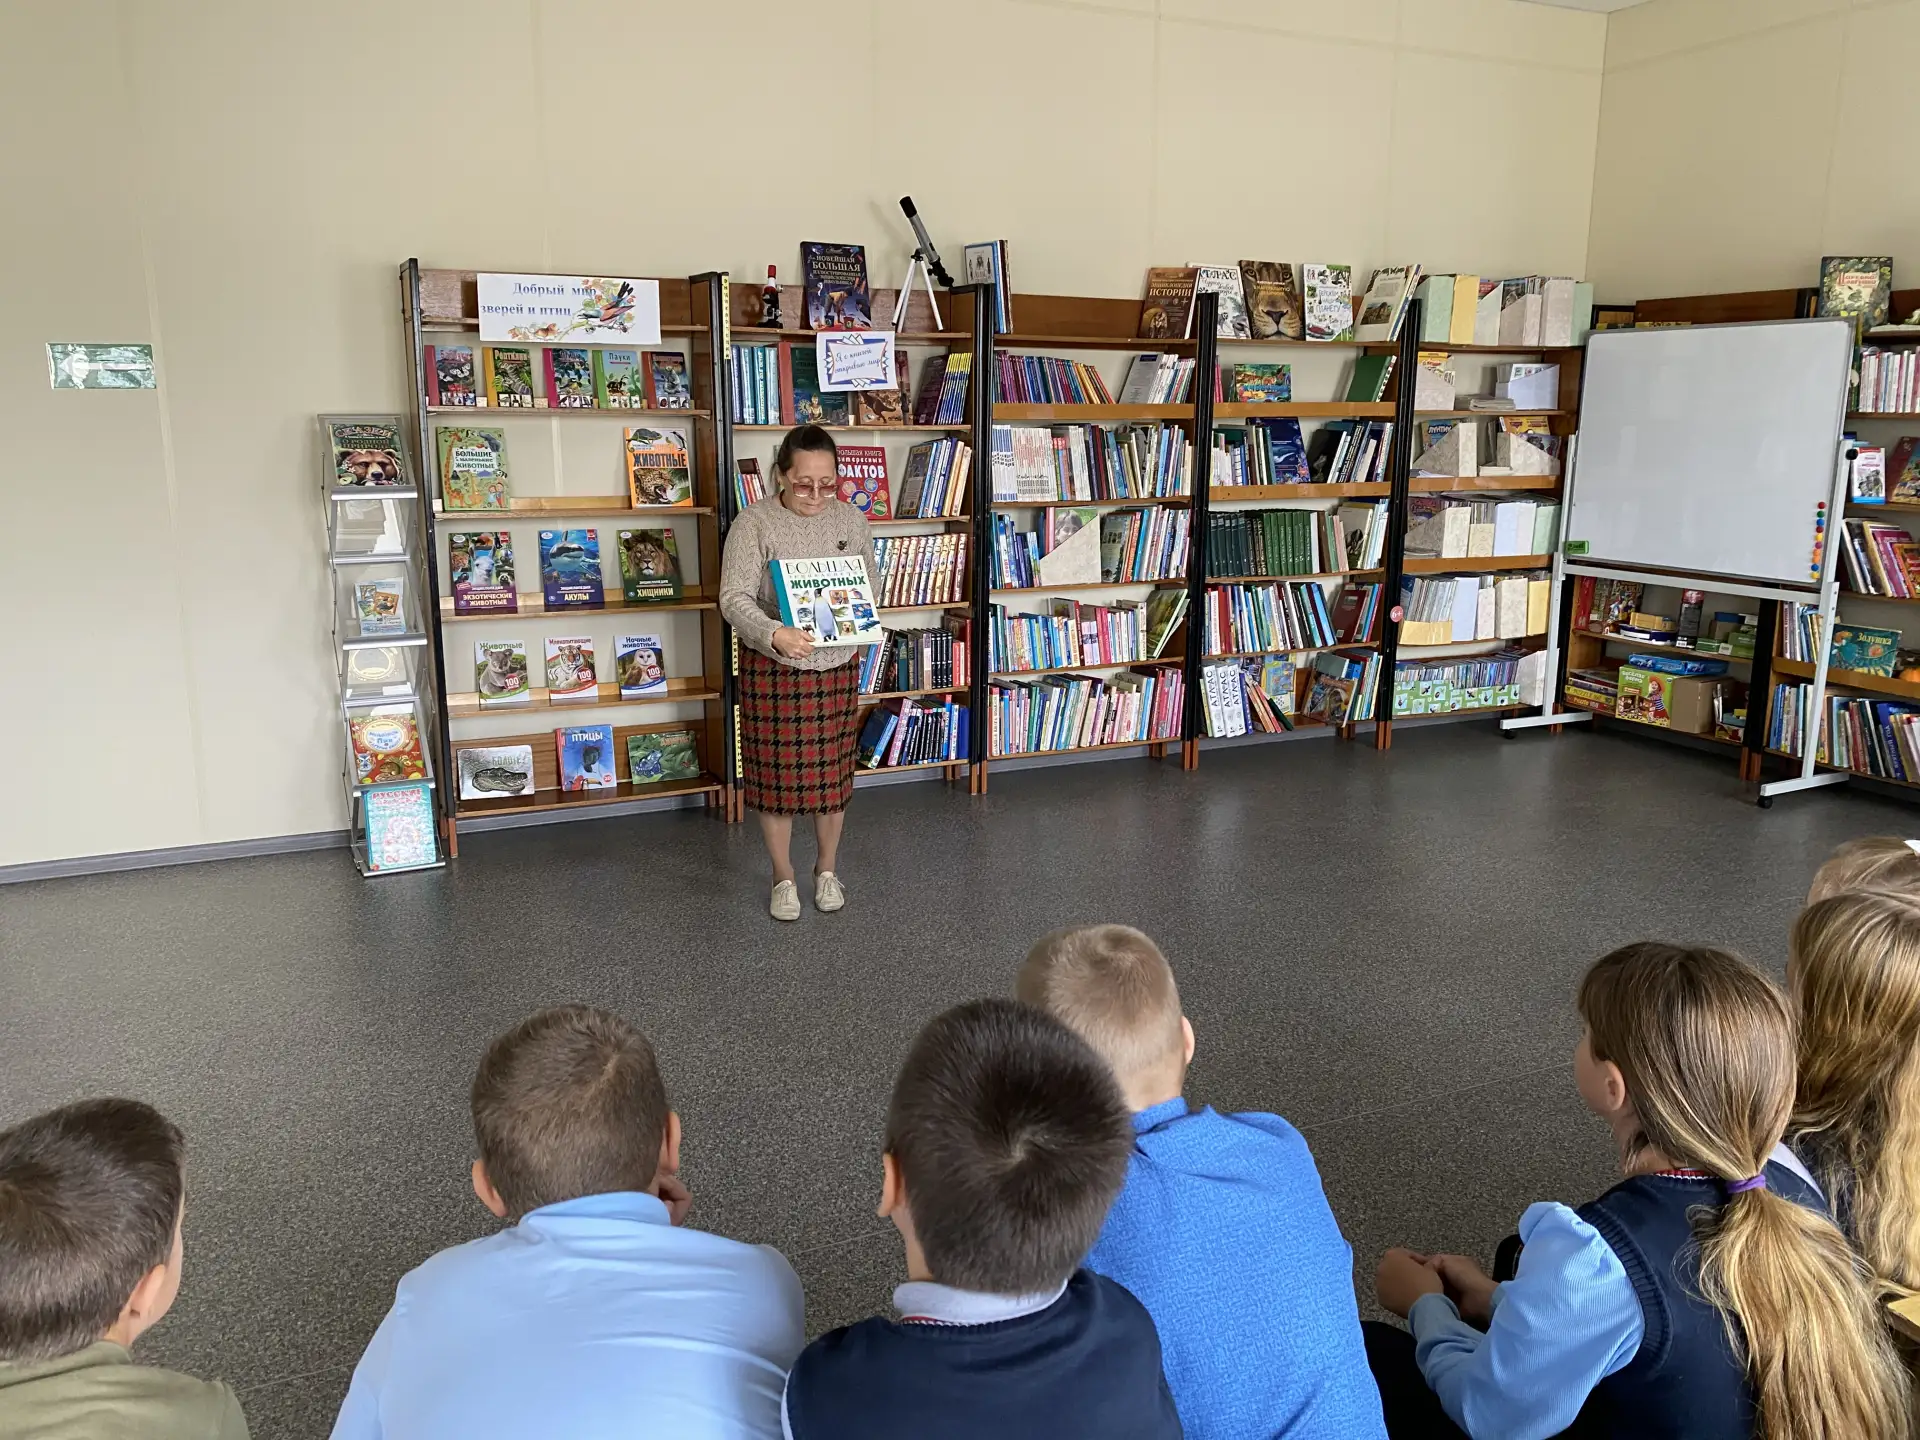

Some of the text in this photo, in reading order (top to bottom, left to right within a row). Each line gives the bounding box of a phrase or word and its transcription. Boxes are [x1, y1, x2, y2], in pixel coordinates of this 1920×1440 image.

[812, 262, 860, 271] БОЛЬШАЯ
[513, 282, 597, 297] Добрый мир
[1149, 288, 1192, 297] ИСТОРИИ
[480, 303, 571, 317] зверей и птиц
[608, 352, 631, 361] Пауки
[836, 352, 843, 362] Я
[335, 426, 394, 438] СКАЗКИ
[455, 450, 493, 458] БОЛЬШИЕ
[633, 453, 687, 468] ЖИВОТНЫЕ
[838, 464, 885, 479] ФАКТОВ
[785, 559, 862, 575] БОЛЬШАЯ
[790, 576, 866, 589] ЖИВОТНЫХ
[564, 593, 589, 601] АКУЛЫ
[637, 587, 674, 598] ХИЩНИКИ
[1392, 609, 1402, 619] 6+
[1857, 632, 1892, 645] Золушка
[479, 641, 523, 650] Животные
[622, 641, 657, 649] животные
[578, 670, 592, 680] 100
[647, 667, 660, 677] 100
[505, 677, 519, 687] 100
[1206, 670, 1218, 706] АТЛАС
[1220, 671, 1231, 707] АТЛАС
[1230, 670, 1240, 705] АТЛАС
[572, 732, 603, 742] ПТИЦЫ
